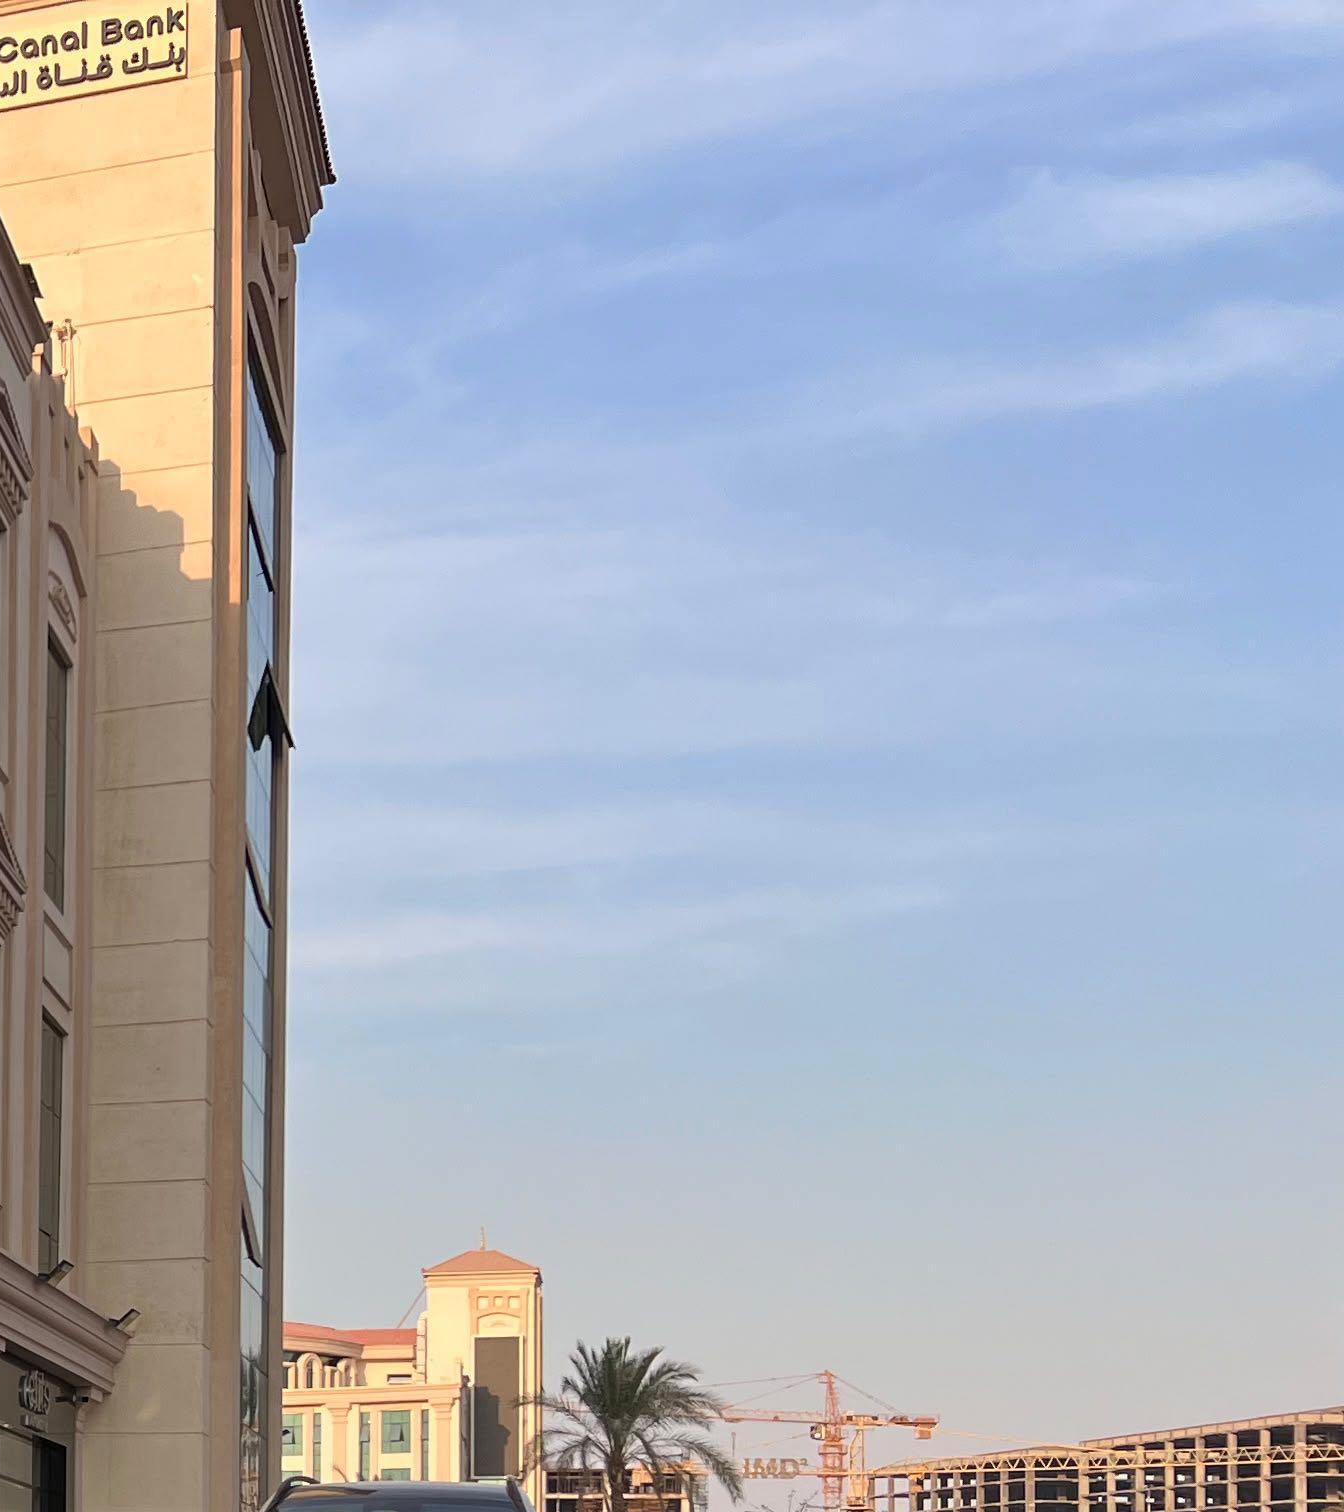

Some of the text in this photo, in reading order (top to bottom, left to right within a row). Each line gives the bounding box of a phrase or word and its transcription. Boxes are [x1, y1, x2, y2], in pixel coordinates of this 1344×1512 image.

[101, 7, 186, 46] Bank
[36, 54, 113, 90] قناة
[122, 44, 186, 75] بنك
